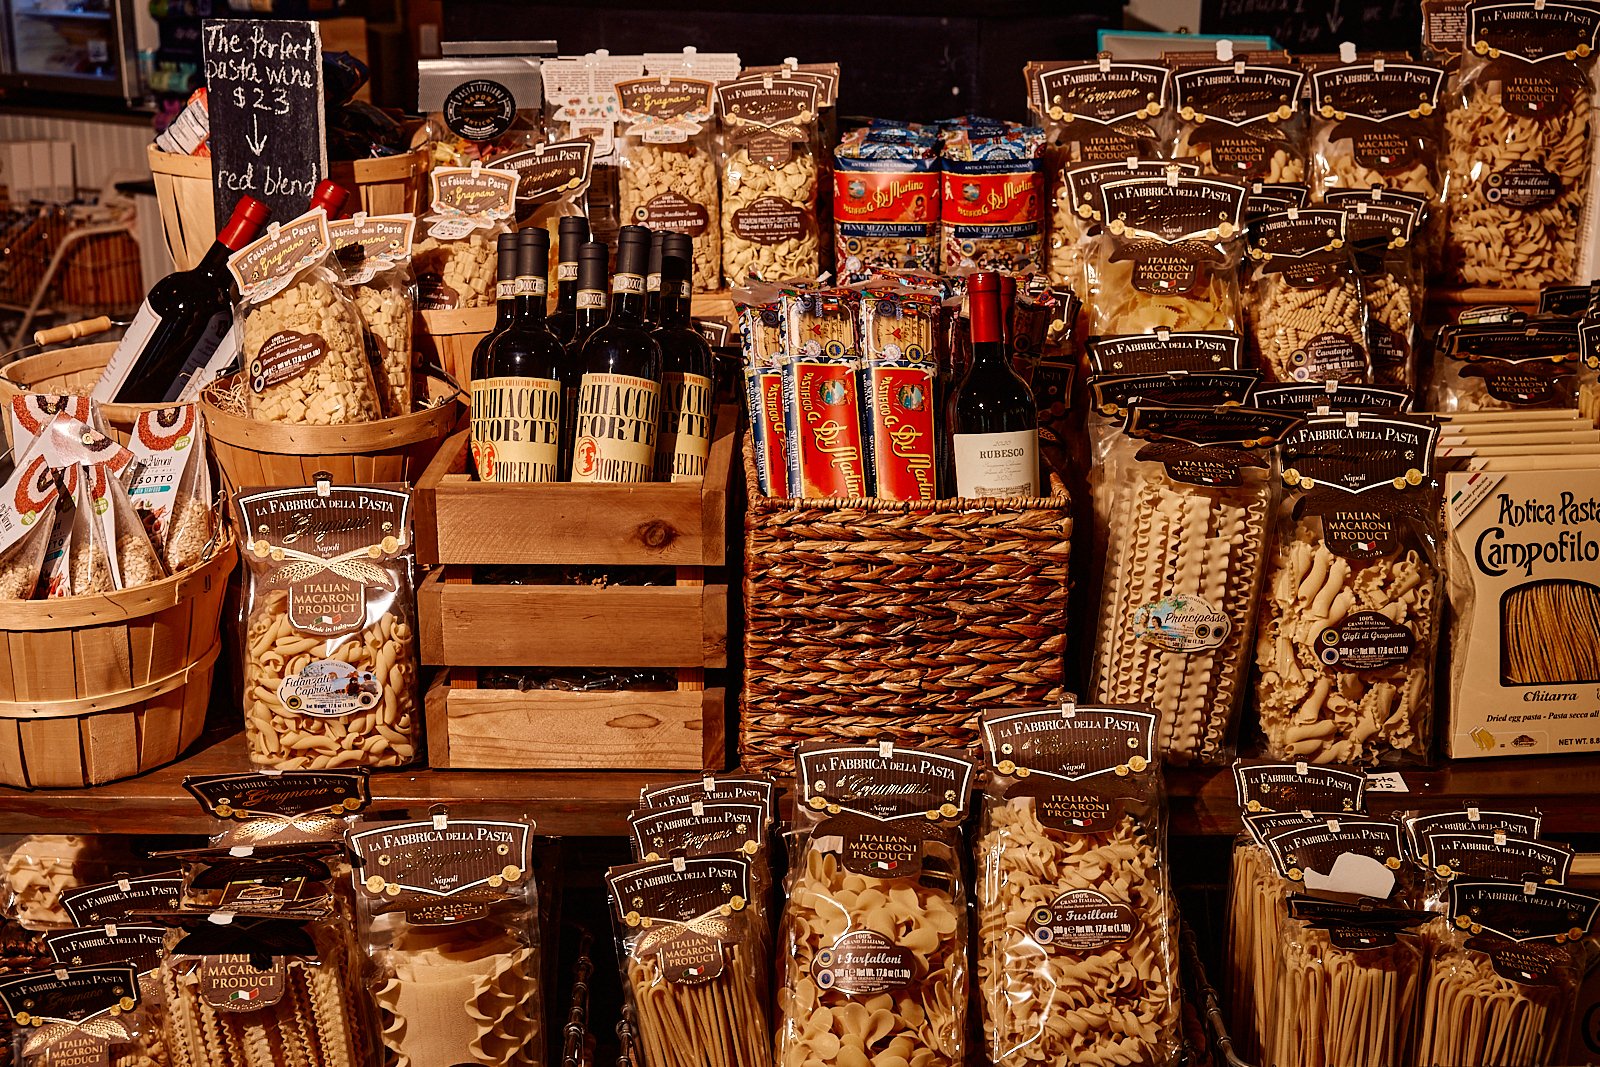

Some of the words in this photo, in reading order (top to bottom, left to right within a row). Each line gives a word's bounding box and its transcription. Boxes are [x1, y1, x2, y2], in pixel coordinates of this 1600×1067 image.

[1482, 15, 1492, 23] LA
[1494, 9, 1539, 22] FABBRICA
[1540, 11, 1563, 20] DELLA
[1565, 11, 1591, 26] PASTA
[205, 25, 242, 53] The
[250, 25, 312, 61] Perfect
[206, 58, 262, 92] pasta
[266, 62, 313, 88] wine
[1514, 77, 1551, 85] ITALIAN
[1506, 86, 1559, 94] MACARONI
[233, 86, 290, 115] $23
[1509, 93, 1555, 102] PRODUCT
[218, 163, 256, 190] red
[264, 163, 317, 198] blend
[1113, 191, 1124, 200] LA
[1125, 186, 1174, 199] FABBRICA
[1175, 189, 1199, 197] DELLA
[1201, 187, 1231, 202] PASTA
[844, 224, 865, 232] PENNE
[866, 224, 897, 233] MEZZANI
[897, 224, 922, 233] RIGATE
[958, 225, 980, 234] PENNE
[981, 225, 1012, 234] MEZZANI
[1138, 264, 1194, 273] MACARONI
[1140, 272, 1190, 280] PRODUCT
[800, 372, 815, 411] PASTIFICIO
[879, 376, 893, 415] PASTIFICIO
[580, 384, 659, 424] GHIACCIO
[484, 419, 557, 445] FORTE
[578, 415, 657, 447] FORTE
[1287, 434, 1298, 445] LA
[1299, 428, 1354, 443] FABBRICA
[1355, 430, 1383, 440] DELLA
[1385, 428, 1419, 445] PASTA
[979, 447, 1024, 459] RUBESCO
[256, 508, 268, 516] LA
[269, 499, 327, 514] FABBRICA
[328, 501, 356, 509] DELLA
[358, 496, 394, 512] PASTA
[1497, 493, 1555, 527] Antica
[1336, 512, 1381, 521] ITALIAN
[1329, 521, 1392, 531] MACARONI
[1333, 530, 1389, 541] PRODUCT
[303, 584, 350, 593] ITALIAN
[294, 594, 360, 603] MACARONI
[298, 604, 357, 614] PRODUCT
[1164, 612, 1226, 625] Principesse
[1342, 631, 1360, 641] Gigli
[1361, 631, 1369, 640] di
[1371, 631, 1406, 641] Gragnano
[1523, 690, 1578, 702] Chitarra
[1487, 714, 1507, 722] Dried
[1522, 714, 1541, 723] pasta
[1000, 730, 1012, 738] LA
[1013, 719, 1070, 734] FABBRICA
[1074, 720, 1101, 729] DELLA
[1104, 717, 1140, 732] PASTA
[1575, 737, 1588, 745] WT.
[815, 763, 827, 772] LA
[829, 756, 887, 772] FABBRICA
[890, 762, 917, 771] DELLA
[919, 762, 955, 780] PASTA
[1059, 763, 1085, 771] Napoli
[1260, 773, 1301, 783] FABBRICA
[1304, 777, 1324, 785] DELLA
[1326, 777, 1352, 791] PASTA
[243, 787, 328, 810] Gragnano
[1042, 802, 1110, 811] MACARONI
[1047, 810, 1108, 819] PRODUCT
[645, 826, 655, 835] LA
[656, 816, 699, 832] FABBRICA
[701, 815, 722, 824] DELLA
[724, 812, 751, 824] PASTA
[369, 843, 381, 851] LA
[382, 833, 444, 849] FABBRICA
[446, 831, 475, 841] DELLA
[476, 828, 514, 842] PASTA
[859, 834, 908, 842] ITALIAN
[1294, 834, 1338, 848] FABBRICA
[1340, 832, 1360, 841] DELLA
[1362, 830, 1390, 841] PASTA
[850, 843, 917, 852] MACARONI
[853, 851, 914, 861] PRODUCT
[430, 874, 458, 884] Napoli
[625, 884, 634, 894] LA
[635, 872, 682, 890] FABBRICA
[684, 872, 705, 880] DELLA
[708, 867, 737, 878] PASTA
[78, 903, 86, 911] LA
[86, 893, 129, 908] FABBRICA
[130, 890, 149, 898] DELLA
[151, 886, 178, 896] PASTA
[1066, 910, 1118, 921] Fusilloni
[844, 953, 901, 966] Farfalloni
[208, 963, 279, 976] MACARONI
[212, 976, 275, 988] PRODUCT
